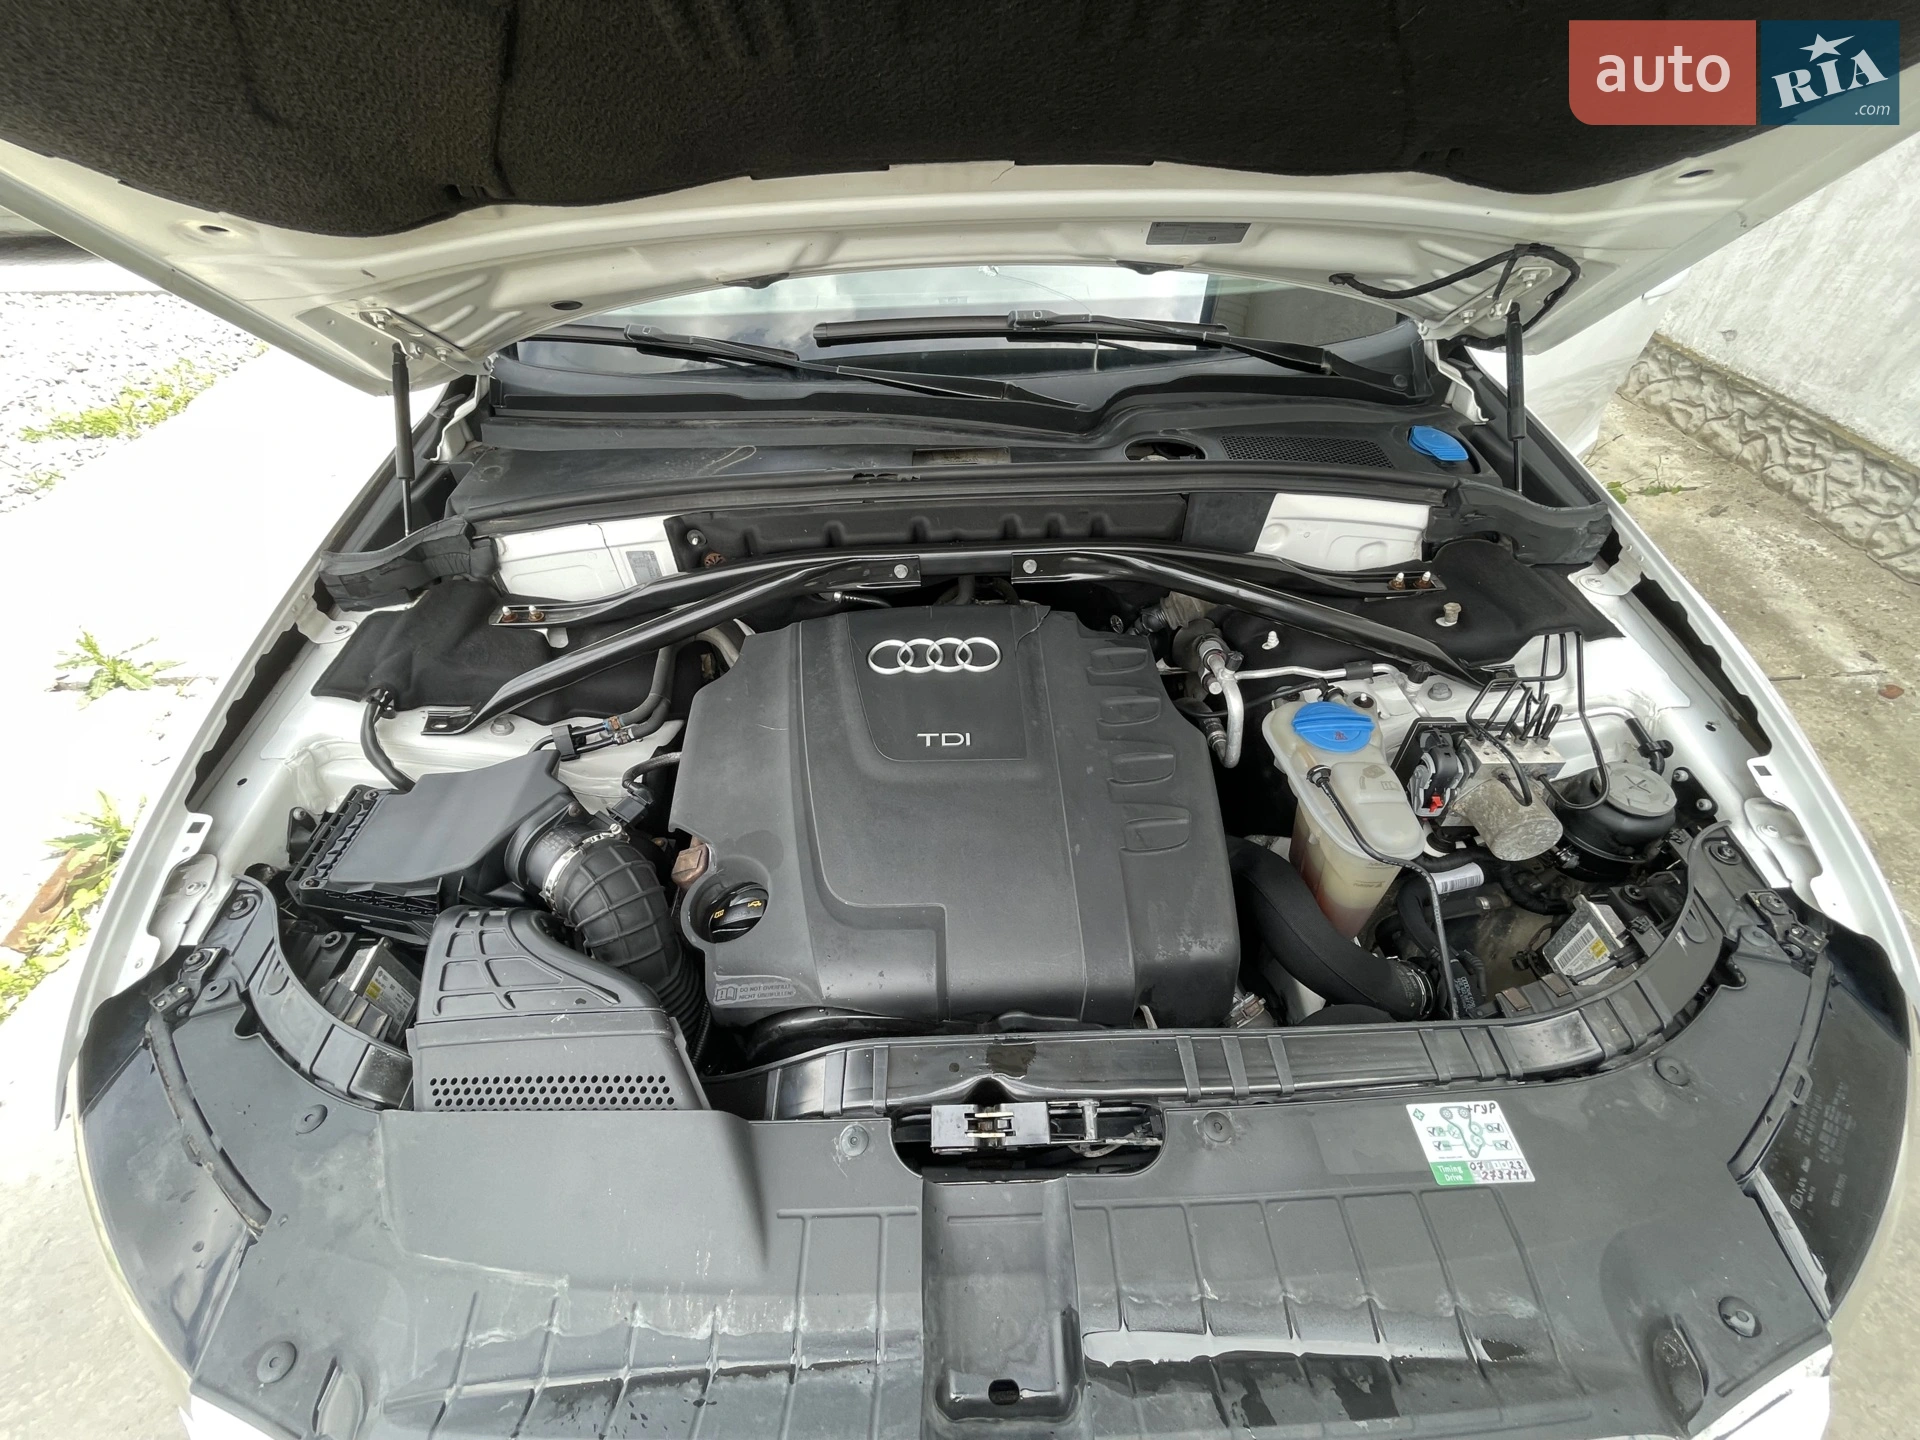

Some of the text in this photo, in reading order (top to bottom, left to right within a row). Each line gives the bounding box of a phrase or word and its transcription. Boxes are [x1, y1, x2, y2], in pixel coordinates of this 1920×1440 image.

[917, 732, 971, 747] TDI
[1438, 1165, 1463, 1174] Timing
[1445, 1172, 1464, 1181] Drive
